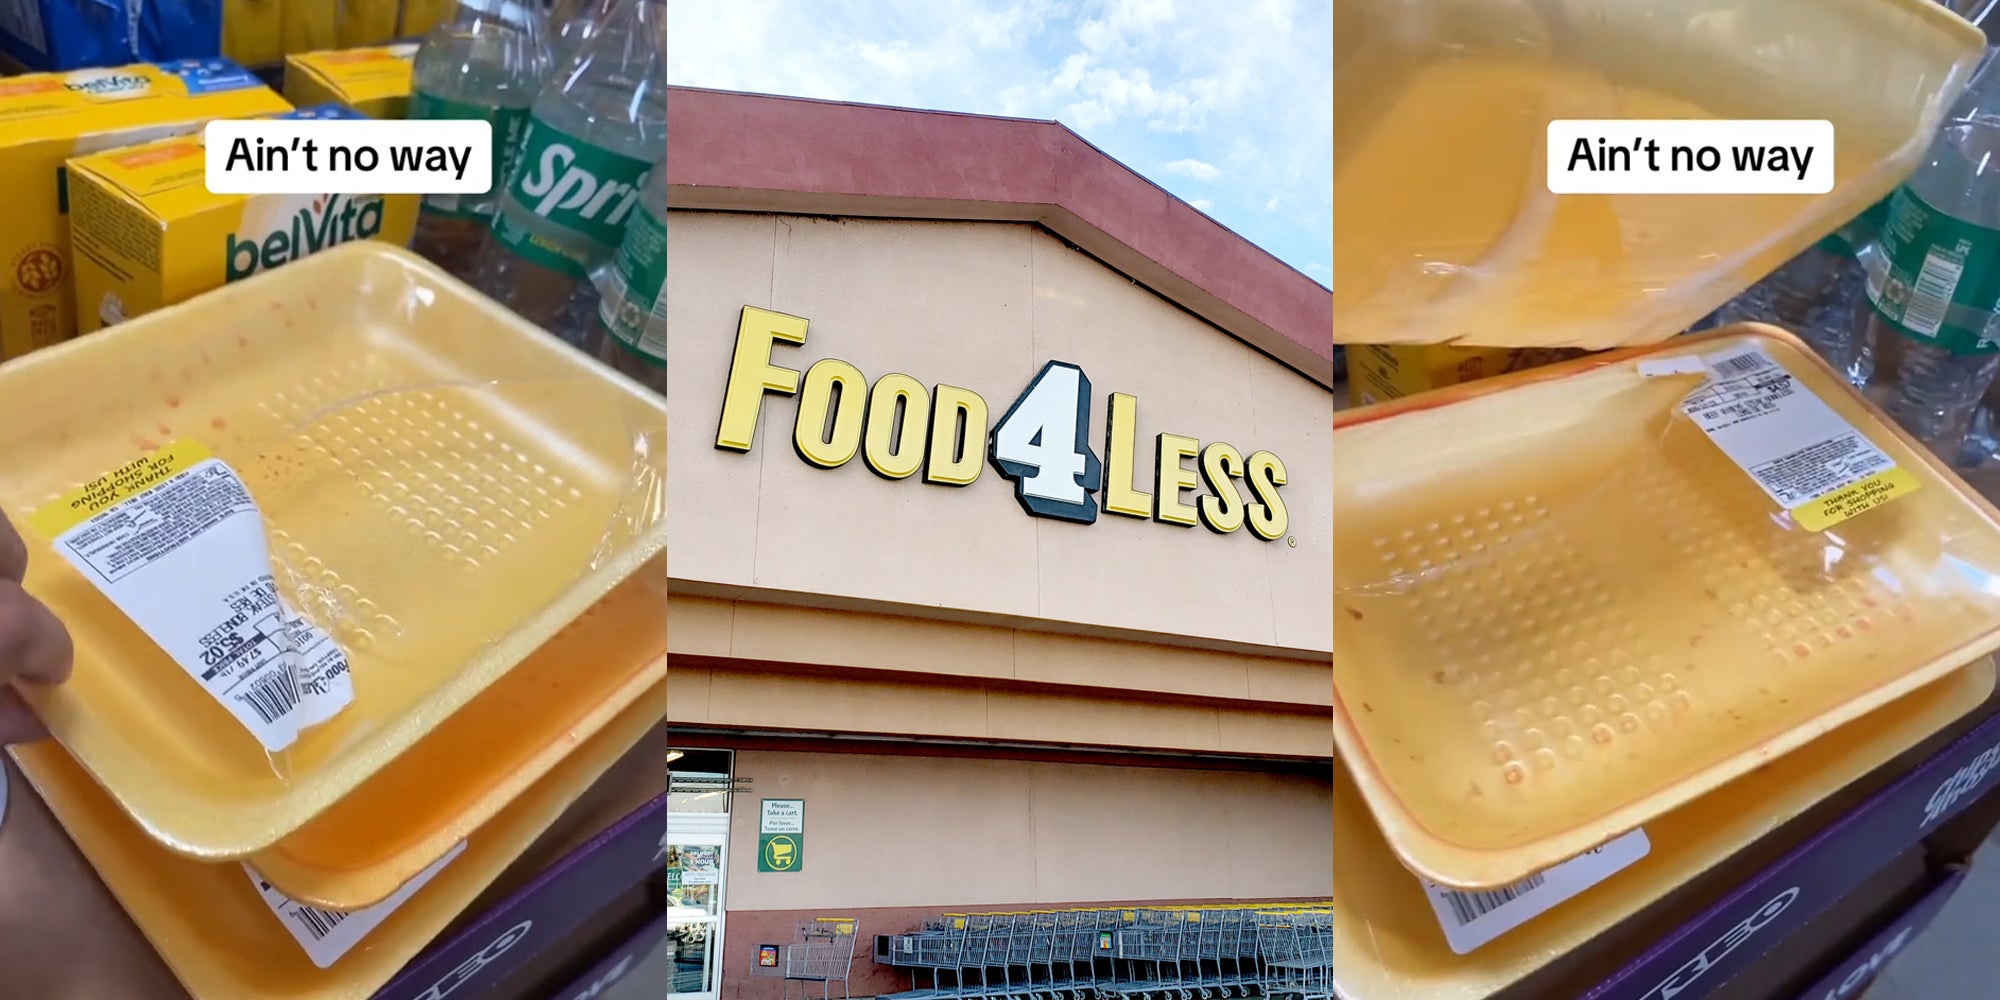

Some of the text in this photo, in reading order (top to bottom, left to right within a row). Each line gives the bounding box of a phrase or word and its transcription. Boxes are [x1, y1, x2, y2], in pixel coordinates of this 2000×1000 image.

[226, 193, 385, 283] belVita
[715, 305, 1288, 541] FOOD 4 LESS
[83, 454, 148, 494] WITH US!
[124, 464, 172, 494] THANK
[147, 453, 174, 472] FOR
[69, 467, 143, 512] SHOPPING
[87, 490, 119, 511] YOU
[1823, 488, 1858, 506] THANK
[1860, 479, 1881, 491] YOU
[1823, 503, 1845, 516] FOR
[1846, 482, 1894, 506] SHOPPING
[1844, 502, 1870, 516] WITH
[197, 610, 248, 648] BONELESS
[198, 628, 244, 668] $5.02
